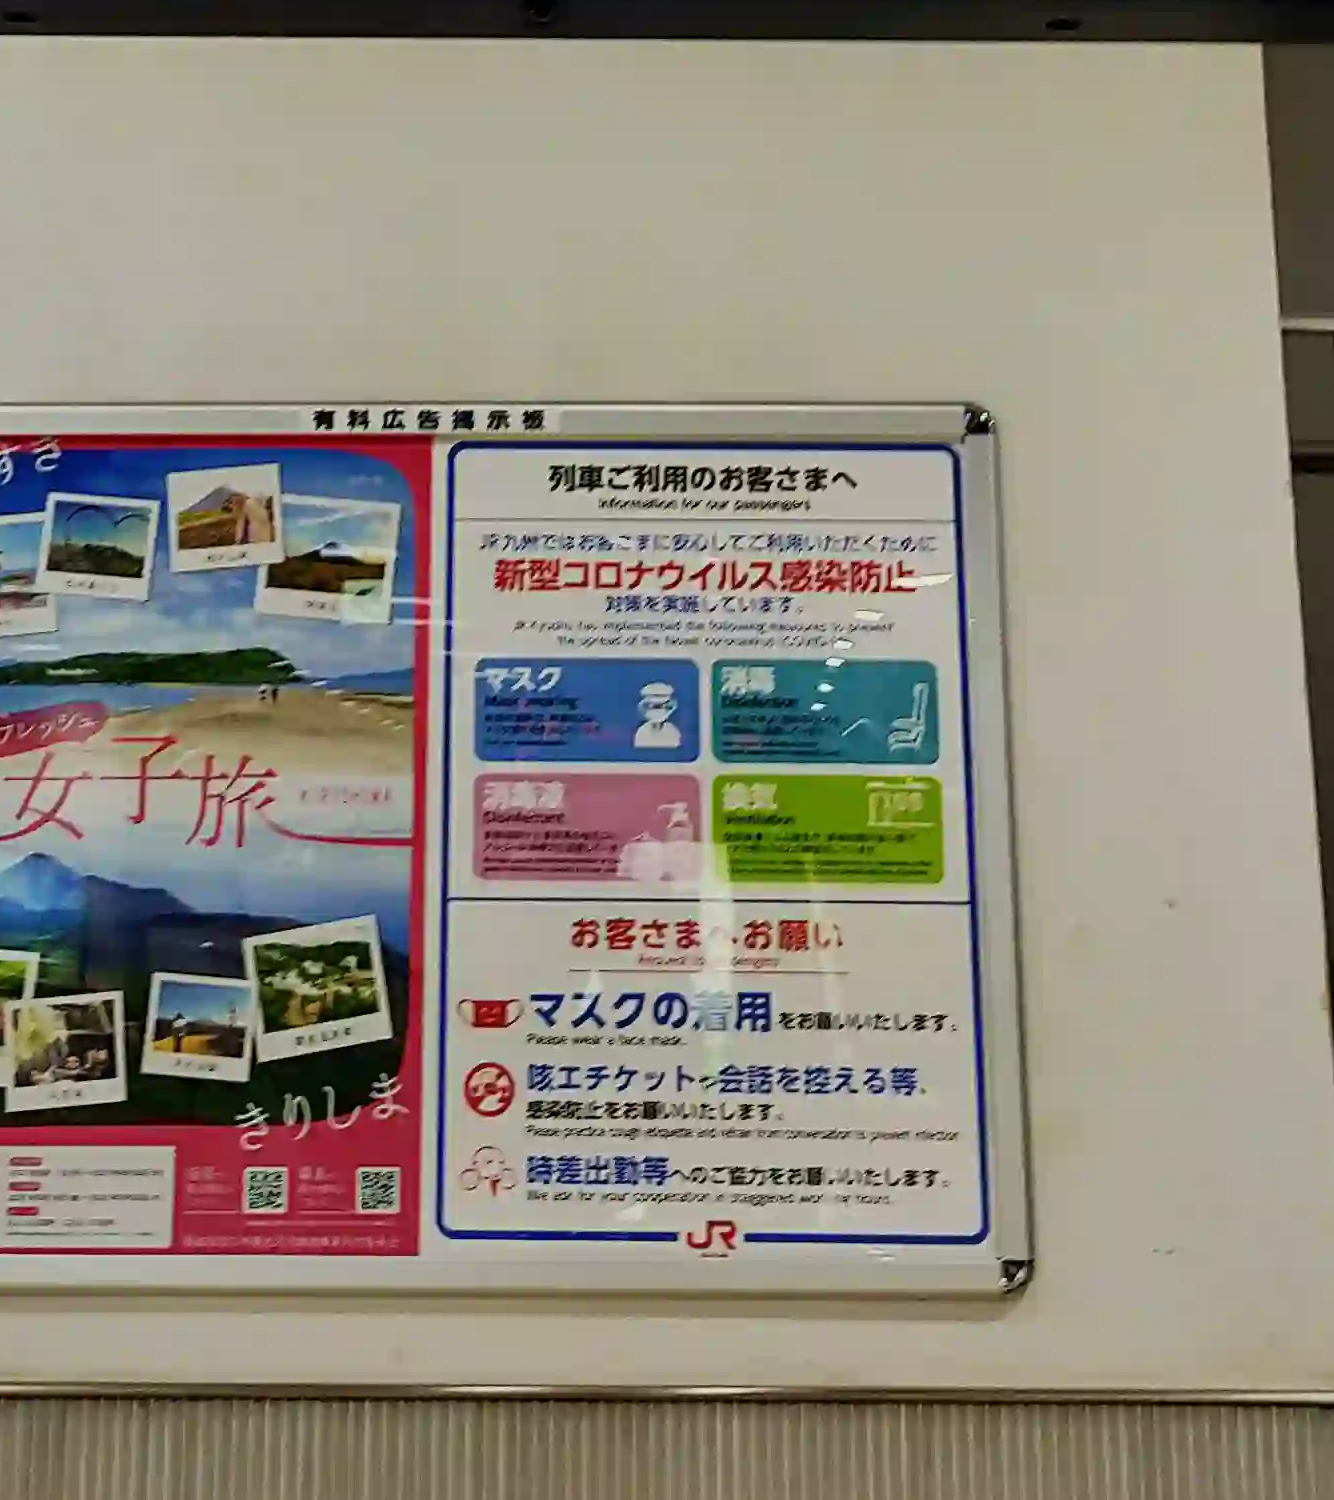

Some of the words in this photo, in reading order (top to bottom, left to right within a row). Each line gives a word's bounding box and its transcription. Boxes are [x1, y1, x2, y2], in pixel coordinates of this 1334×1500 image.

[548, 464, 858, 493] 列車ご利用のお客さまへ
[494, 558, 918, 593] 新型コロナウイルス感染防止
[3, 735, 280, 848] 女子旅
[234, 1072, 410, 1151] きりしま
[687, 1220, 737, 1250] JR
